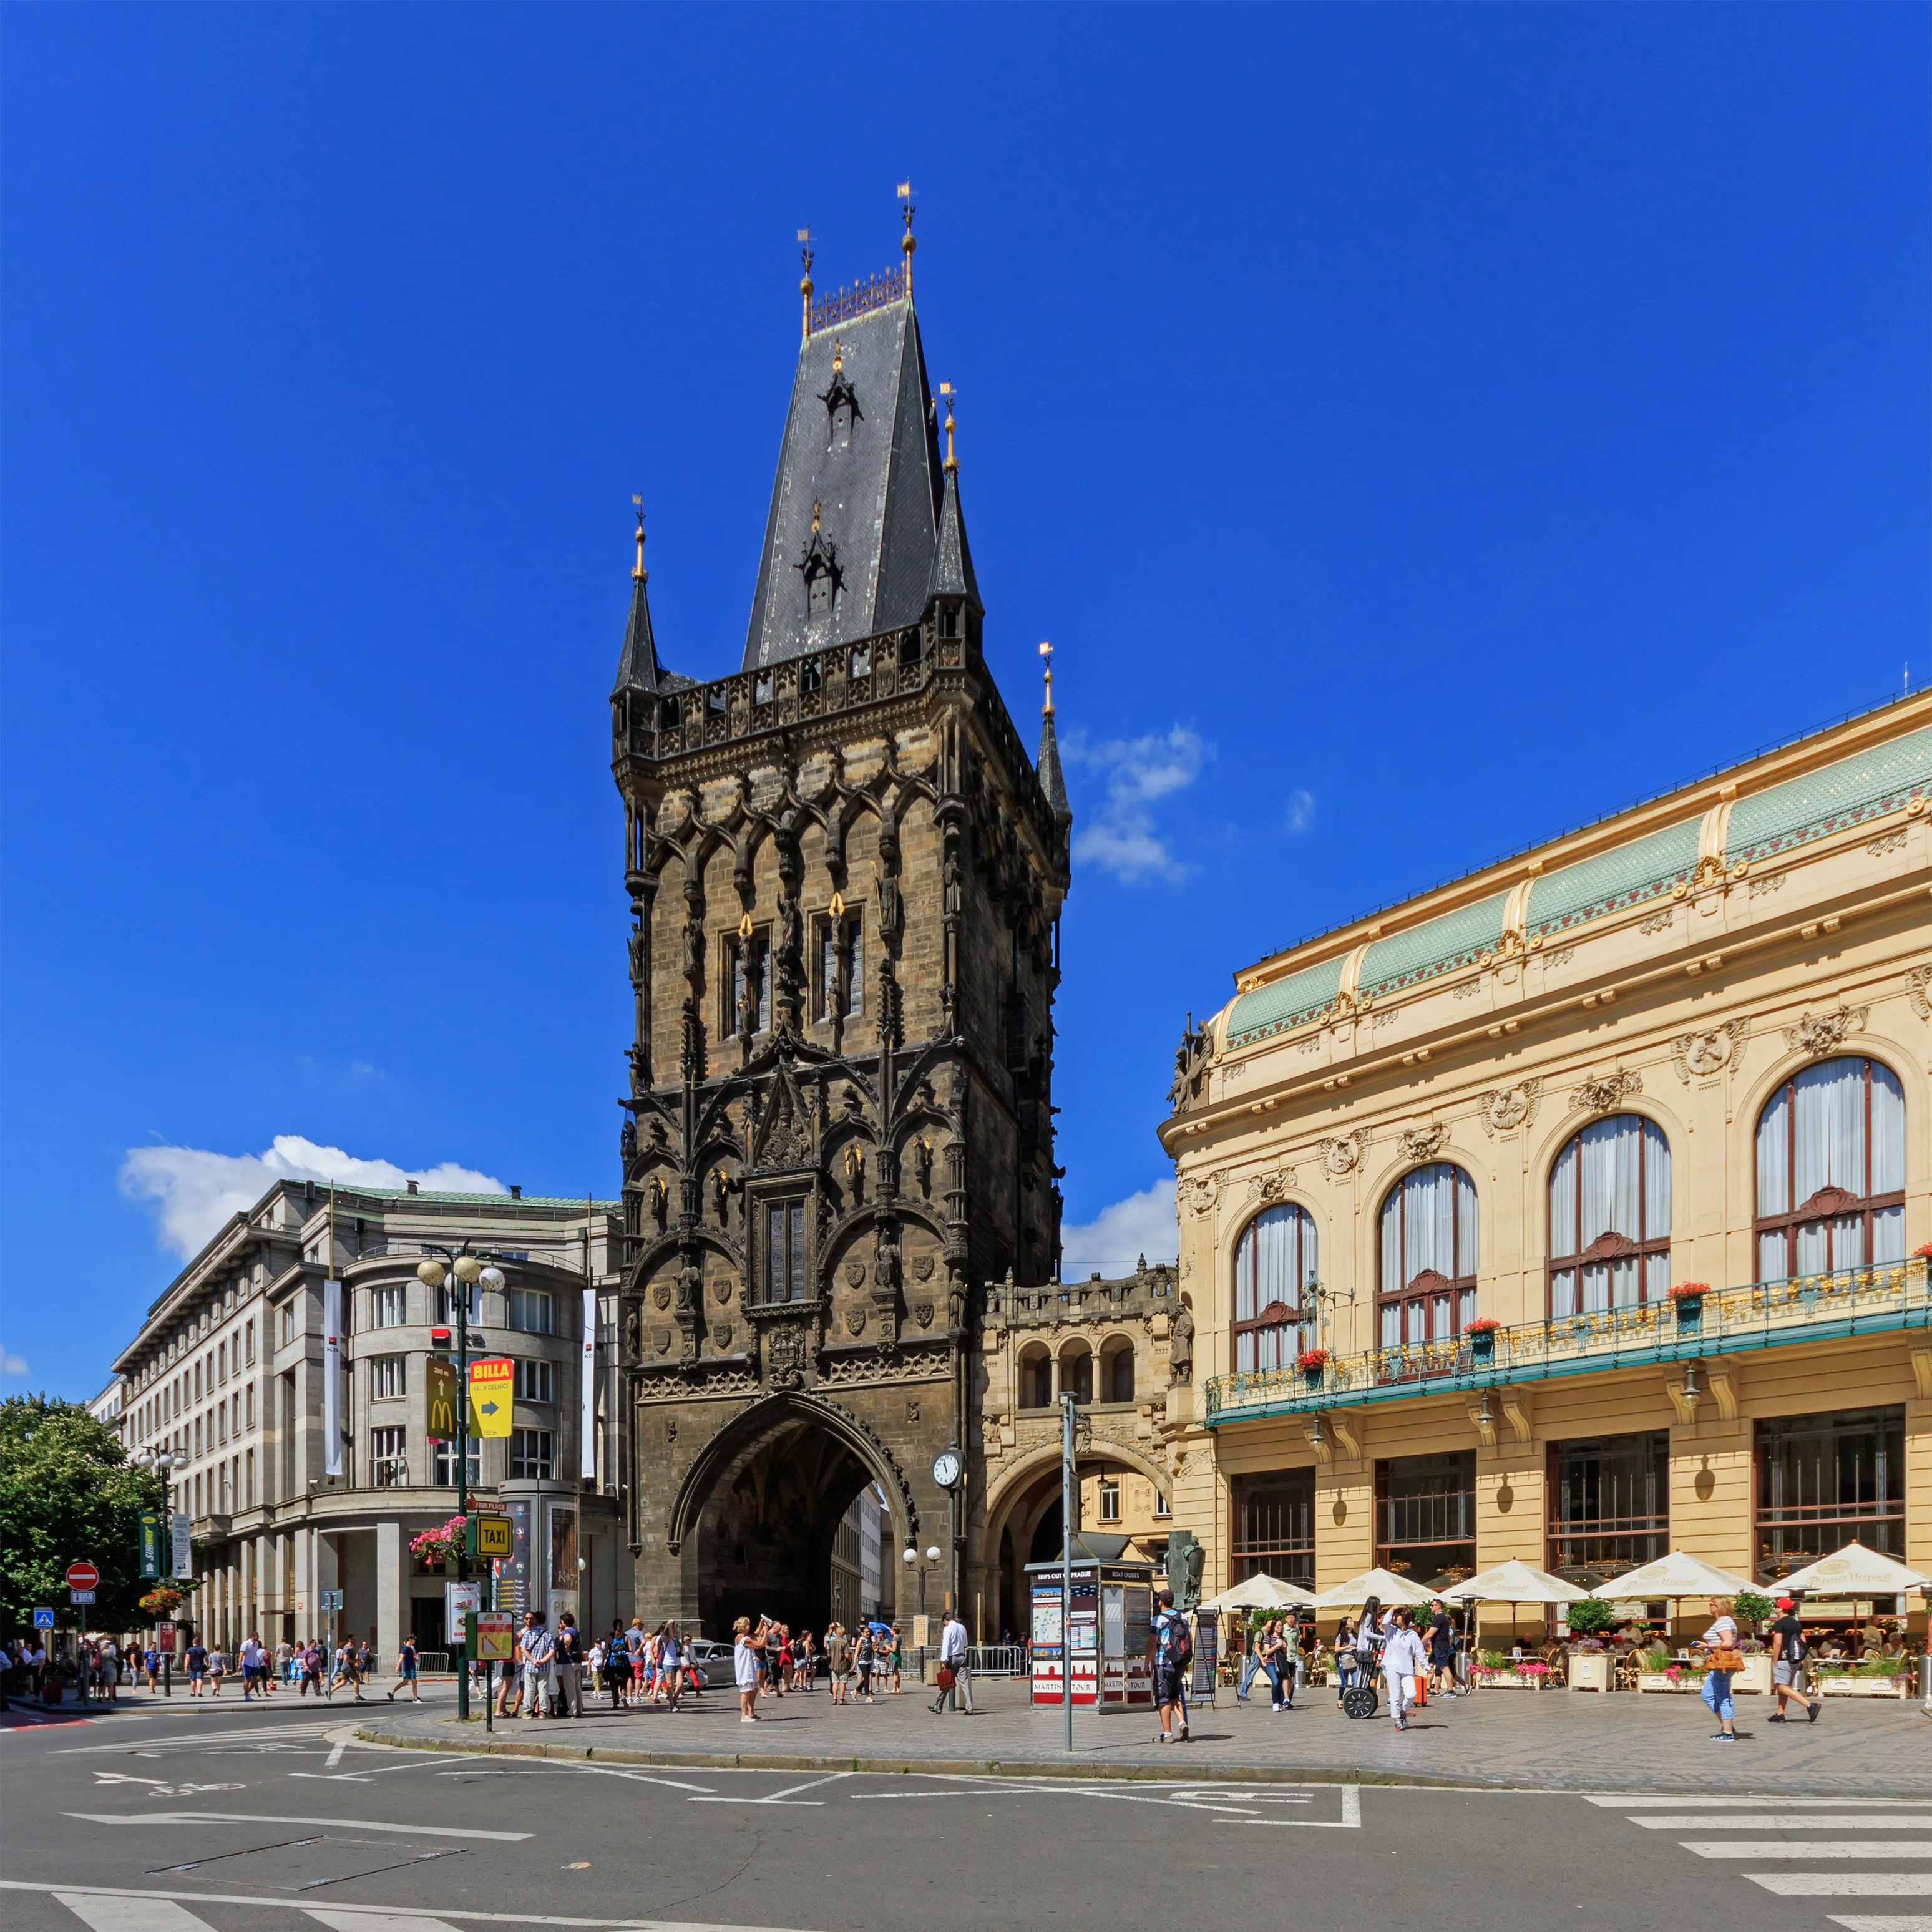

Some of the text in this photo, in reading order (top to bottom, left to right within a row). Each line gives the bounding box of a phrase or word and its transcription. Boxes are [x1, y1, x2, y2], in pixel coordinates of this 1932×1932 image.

[434, 1367, 442, 1375] 300
[473, 1364, 510, 1379] BILLA
[144, 1525, 154, 1561] SUBWAY
[484, 1529, 505, 1544] TAXI
[1661, 1578, 1699, 1587] Urquell
[1807, 1572, 1892, 1586] Pilsner Urquell
[1105, 1680, 1123, 1688] MARTIN
